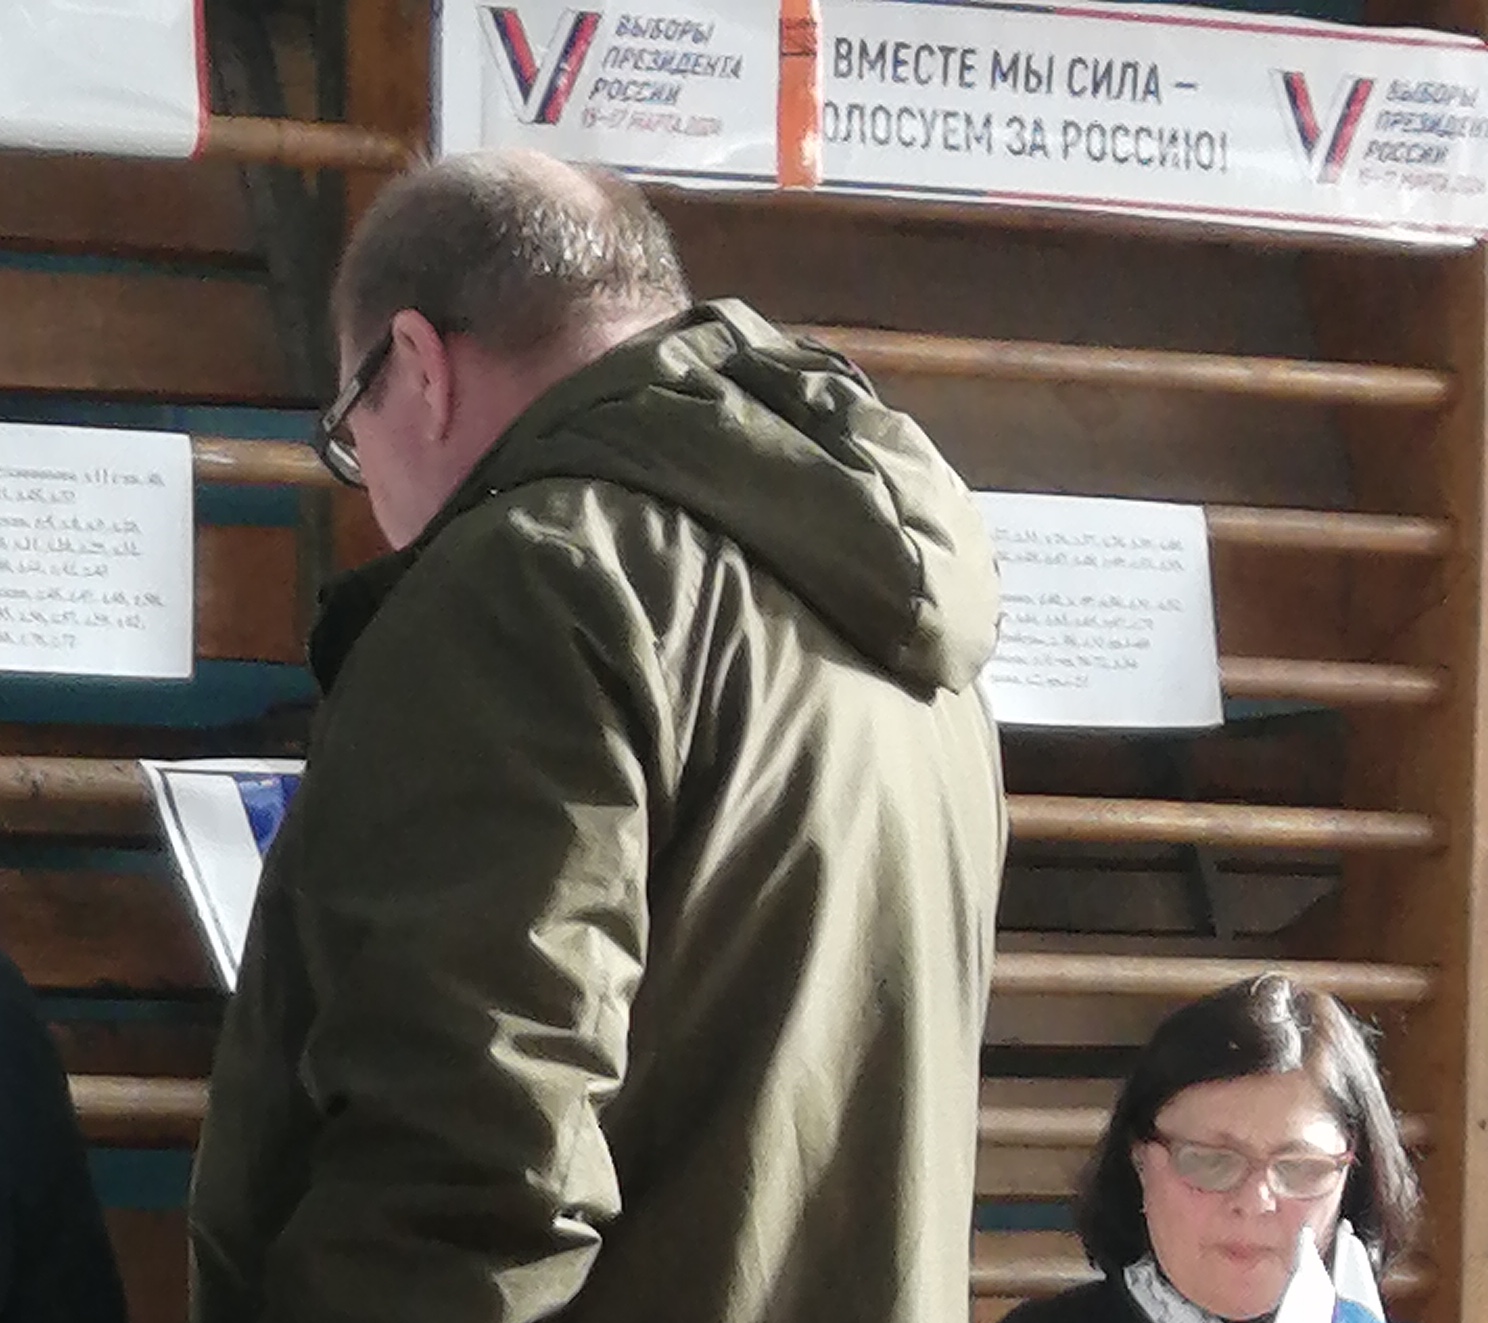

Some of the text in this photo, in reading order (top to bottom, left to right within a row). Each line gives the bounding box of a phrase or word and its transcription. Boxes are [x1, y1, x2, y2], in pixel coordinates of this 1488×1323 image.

[615, 14, 716, 44] ВЫБОРЫ
[832, 36, 979, 90] ВМЕСТЕ
[989, 49, 1056, 97] МЫ
[1066, 56, 1164, 105] СИЛА
[821, 100, 1230, 174] ОЛОСУЕМ ЗА РОССИЮ!
